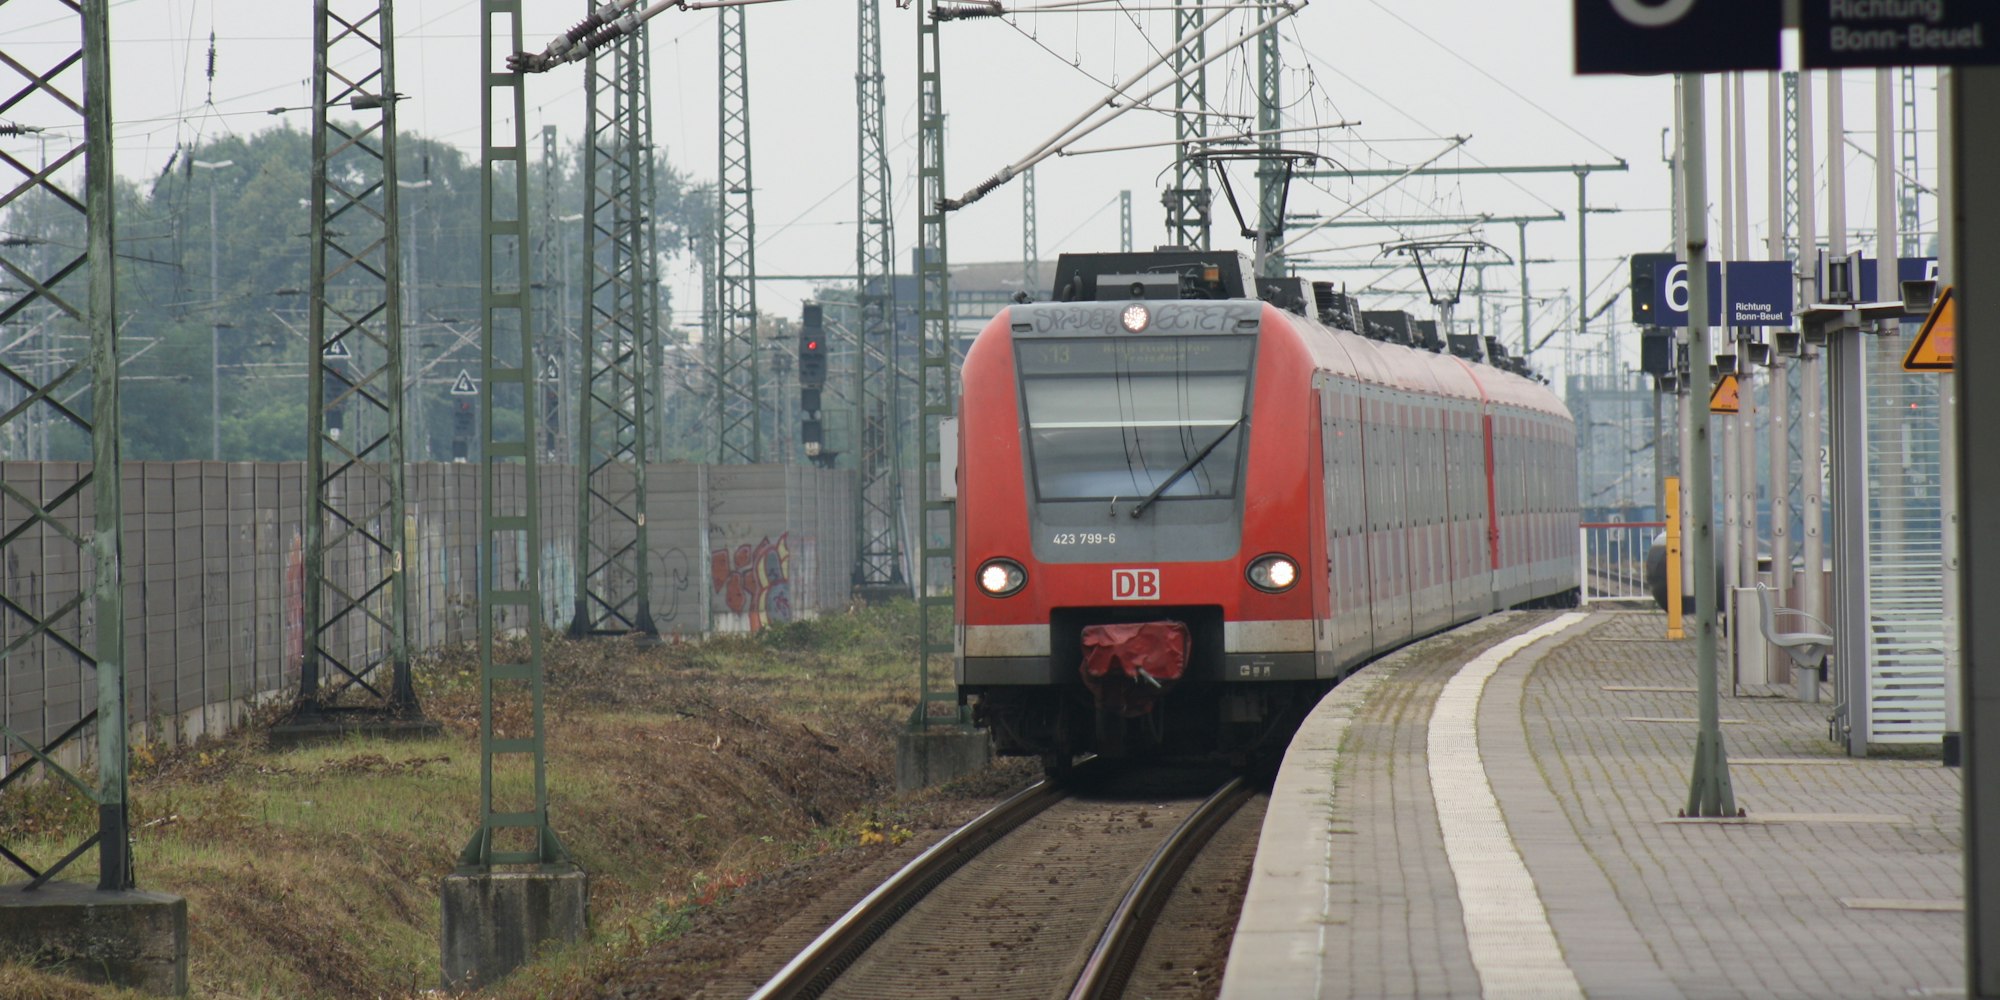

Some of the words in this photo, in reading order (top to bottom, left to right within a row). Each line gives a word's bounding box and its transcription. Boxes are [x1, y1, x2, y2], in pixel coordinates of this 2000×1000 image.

[1830, 0, 1943, 23] Richtung
[1830, 22, 1983, 52] Bonn-Beuel
[1665, 264, 1688, 312] 6
[1736, 302, 1771, 312] Richtung
[1736, 312, 1783, 321] Bonn-Beuel
[459, 377, 469, 390] 4
[1053, 534, 1075, 545] 423
[1080, 533, 1116, 544] 799-6
[1115, 571, 1157, 598] DB
